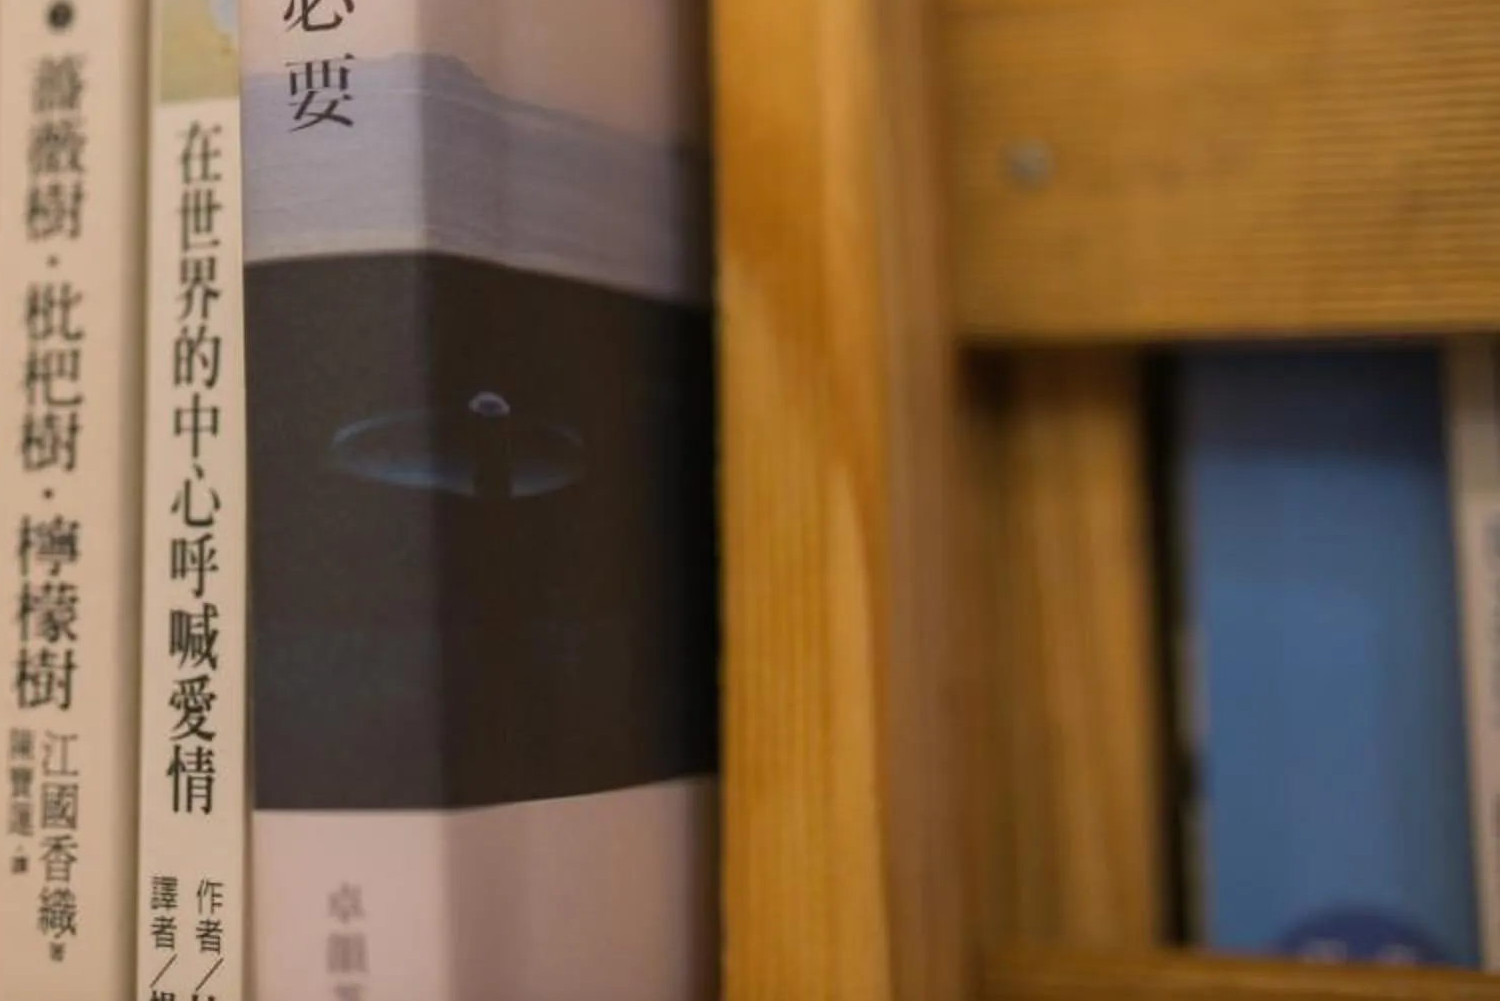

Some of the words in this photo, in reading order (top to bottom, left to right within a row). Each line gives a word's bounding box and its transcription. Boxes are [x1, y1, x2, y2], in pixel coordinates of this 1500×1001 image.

[166, 120, 224, 816] 在世界的中心呼喊愛情
